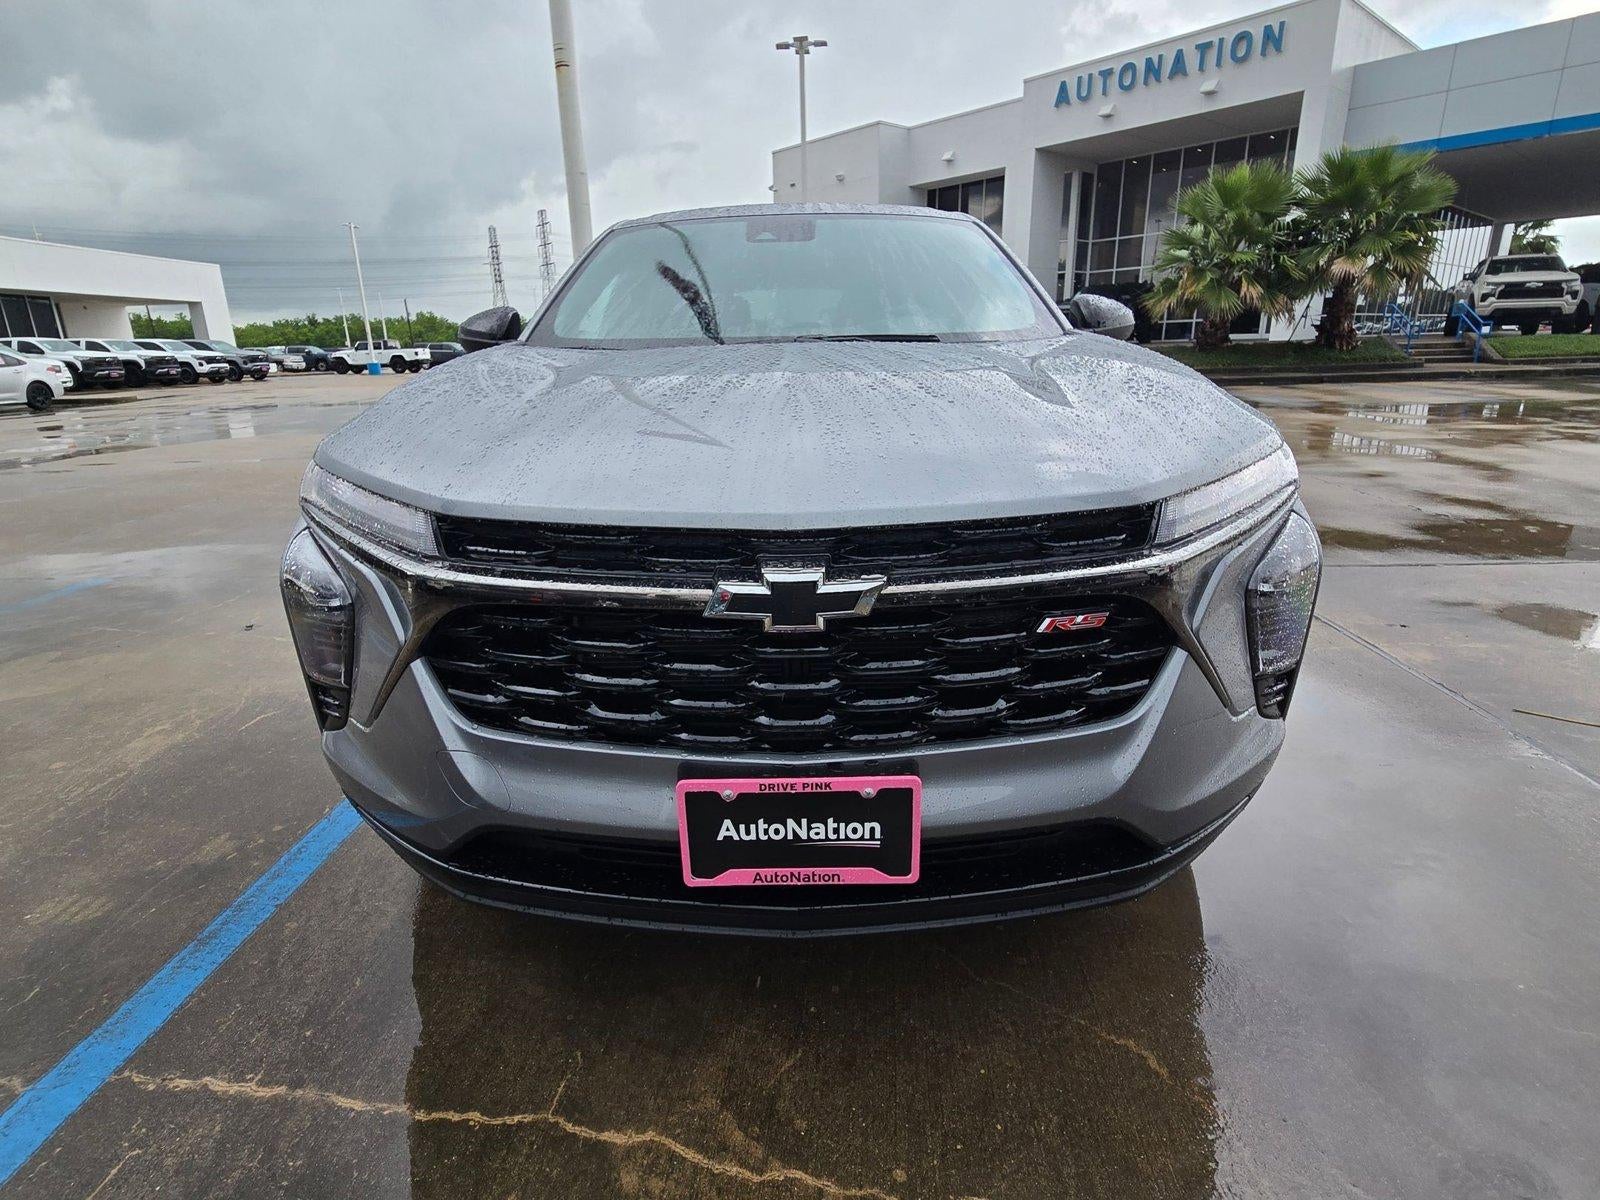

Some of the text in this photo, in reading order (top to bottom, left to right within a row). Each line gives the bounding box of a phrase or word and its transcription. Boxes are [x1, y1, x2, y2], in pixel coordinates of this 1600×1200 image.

[1054, 21, 1286, 108] AUTONATION
[1036, 612, 1109, 633] RS
[758, 781, 833, 792] DRIVE PINK
[716, 817, 882, 841] AutoNation
[752, 871, 841, 884] AutoNation
